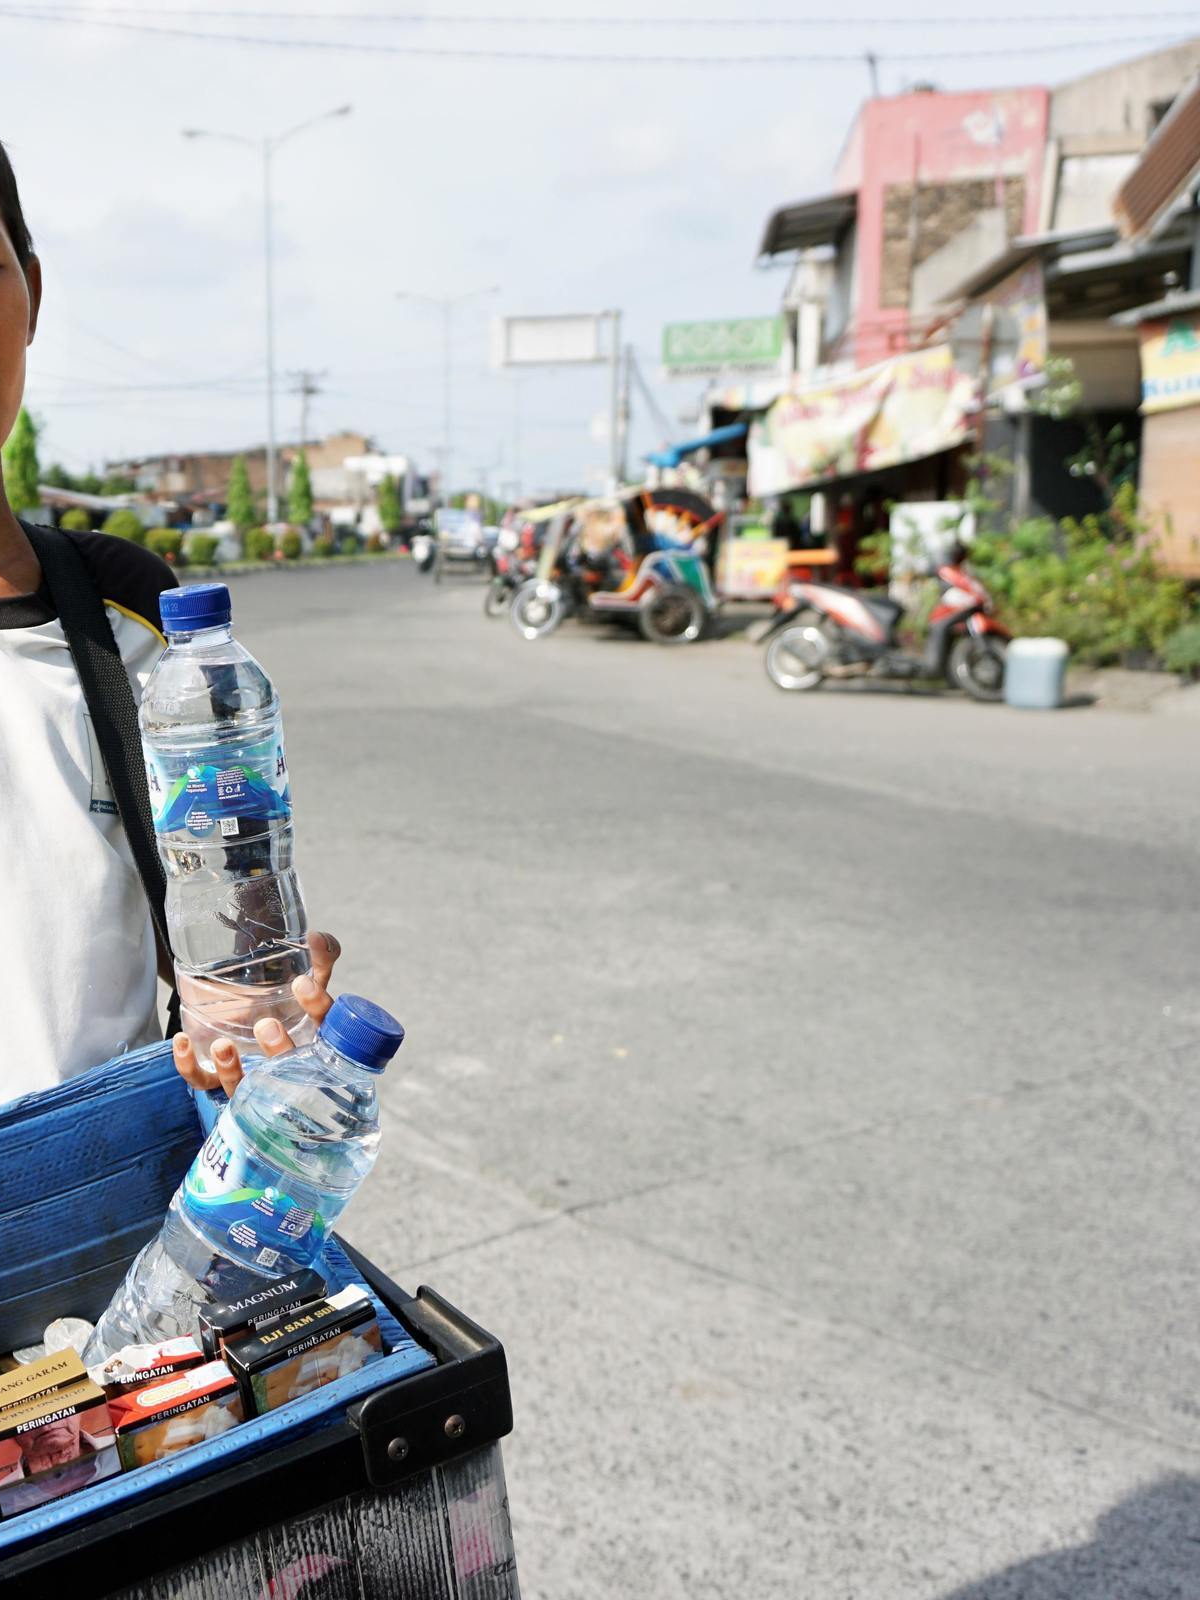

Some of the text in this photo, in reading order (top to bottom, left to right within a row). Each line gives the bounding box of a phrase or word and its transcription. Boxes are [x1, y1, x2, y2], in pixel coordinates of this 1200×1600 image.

[228, 1280, 299, 1314] MAGNUM
[247, 1300, 302, 1327] PERINGATAN
[284, 1314, 315, 1333] SAM
[287, 1327, 341, 1358] PERINGATAN
[26, 1361, 68, 1382] GARAM
[17, 1406, 76, 1434] PERINGATAN
[150, 1395, 210, 1422] PERINGATAN
